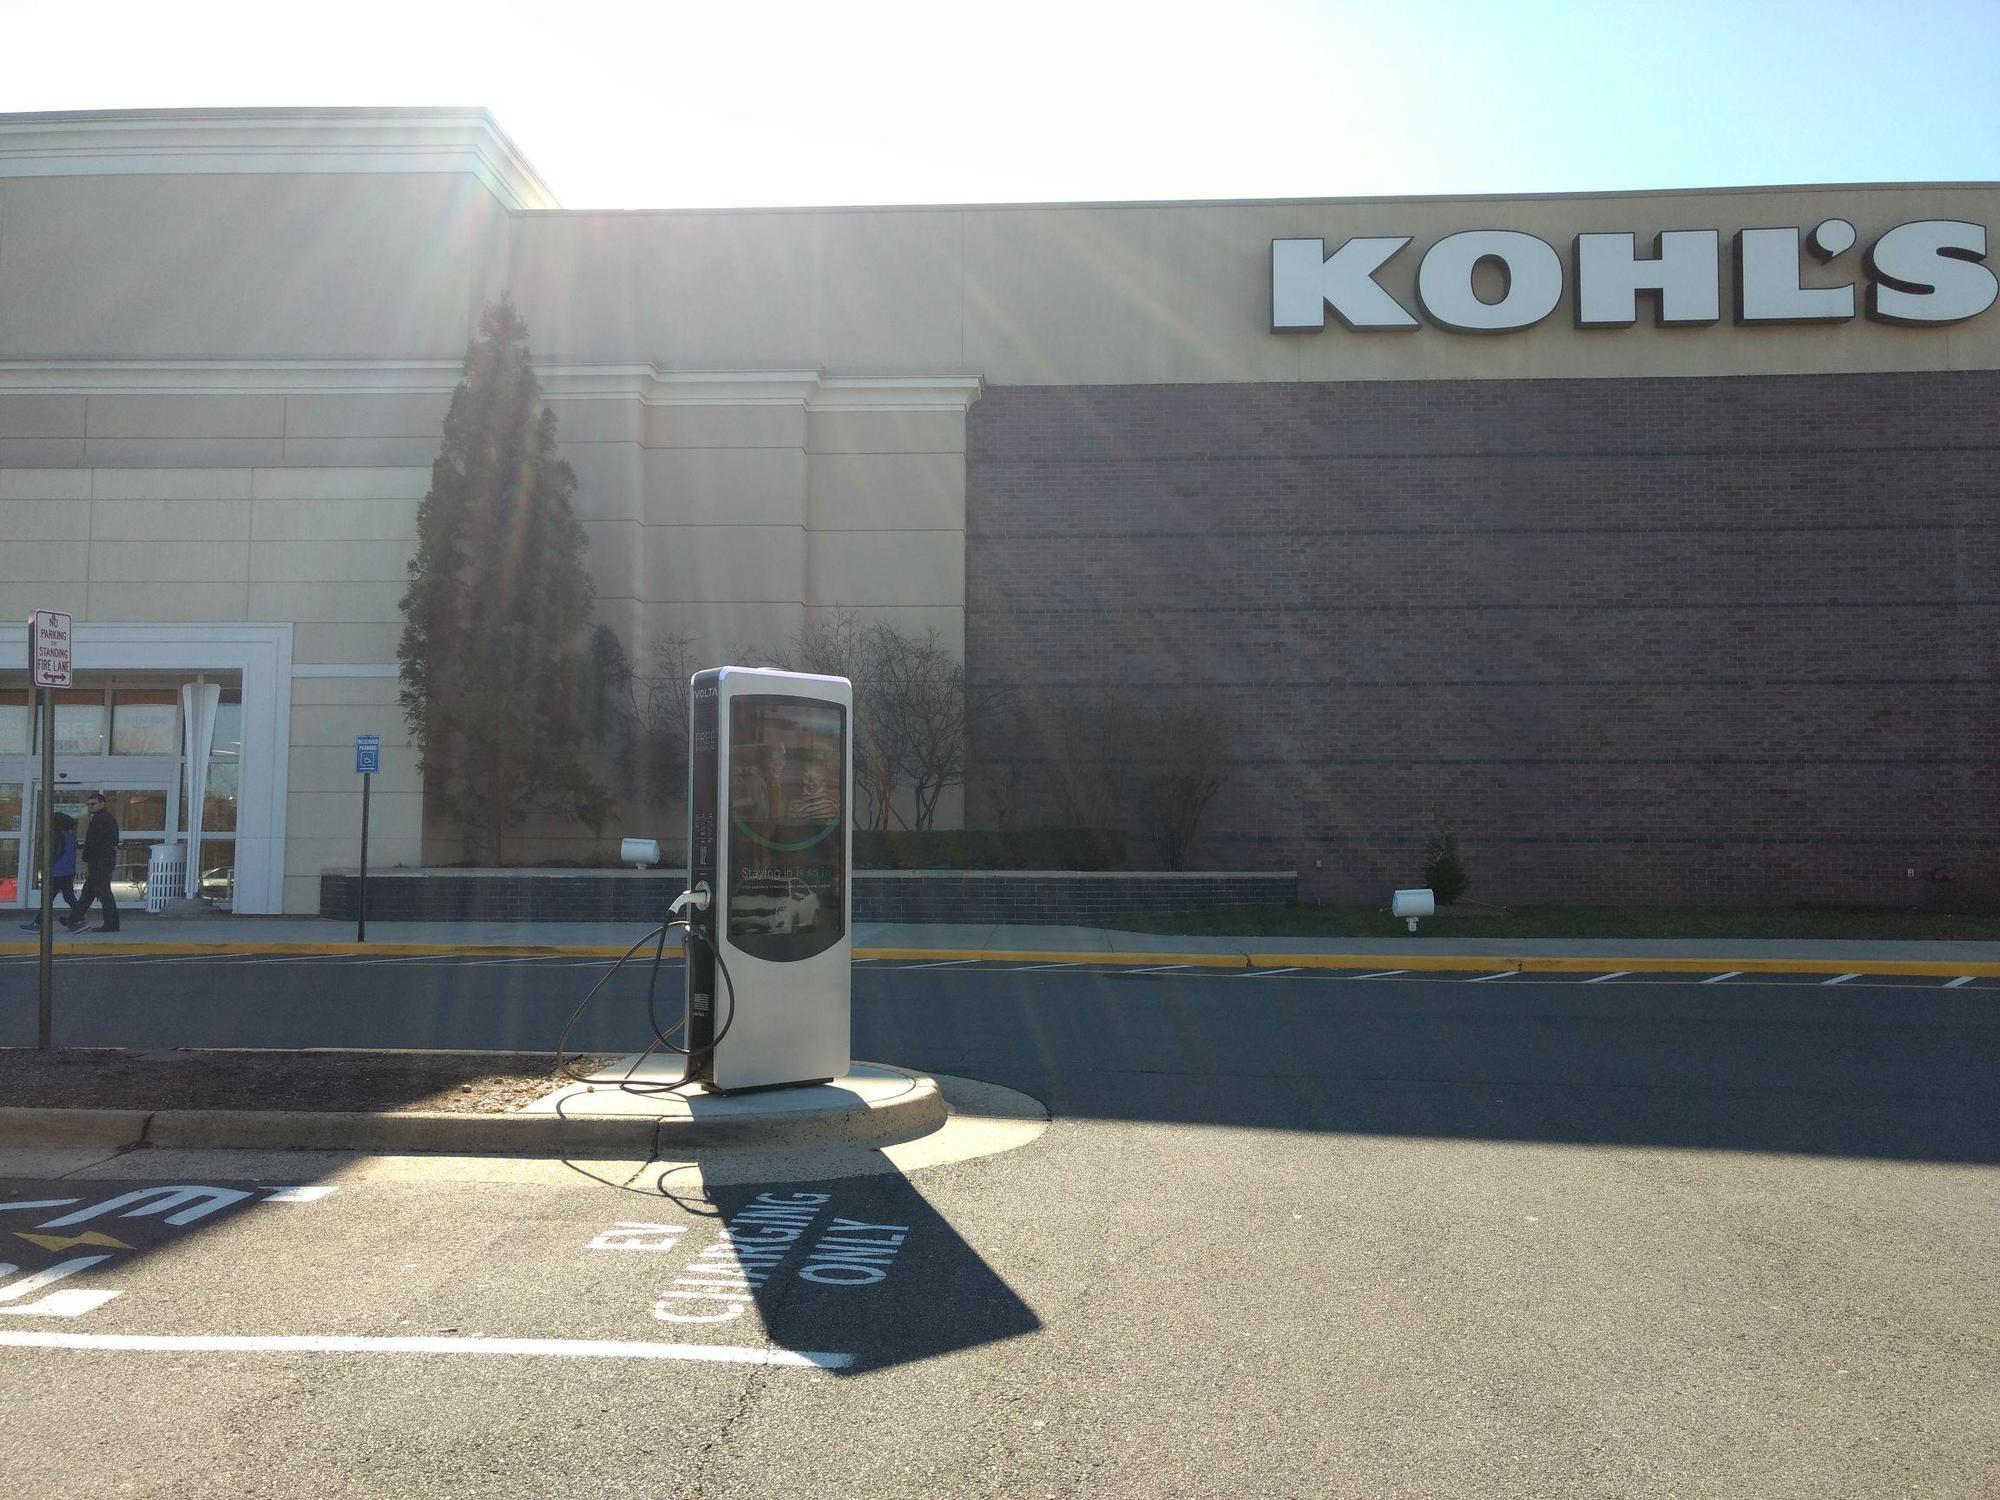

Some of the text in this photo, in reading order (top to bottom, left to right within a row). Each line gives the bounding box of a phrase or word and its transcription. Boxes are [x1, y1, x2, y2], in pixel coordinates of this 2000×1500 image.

[1271, 218, 1999, 334] KOHL'S
[49, 618, 59, 628] NO
[41, 629, 67, 640] PARKING
[39, 647, 69, 660] STANDING
[38, 659, 70, 673] FIRE LANE
[694, 687, 718, 698] VOLTA
[741, 867, 780, 880] Staying
[585, 1219, 690, 1251] EV
[653, 1192, 832, 1324] CHARGING
[799, 1217, 909, 1286] ONLY
